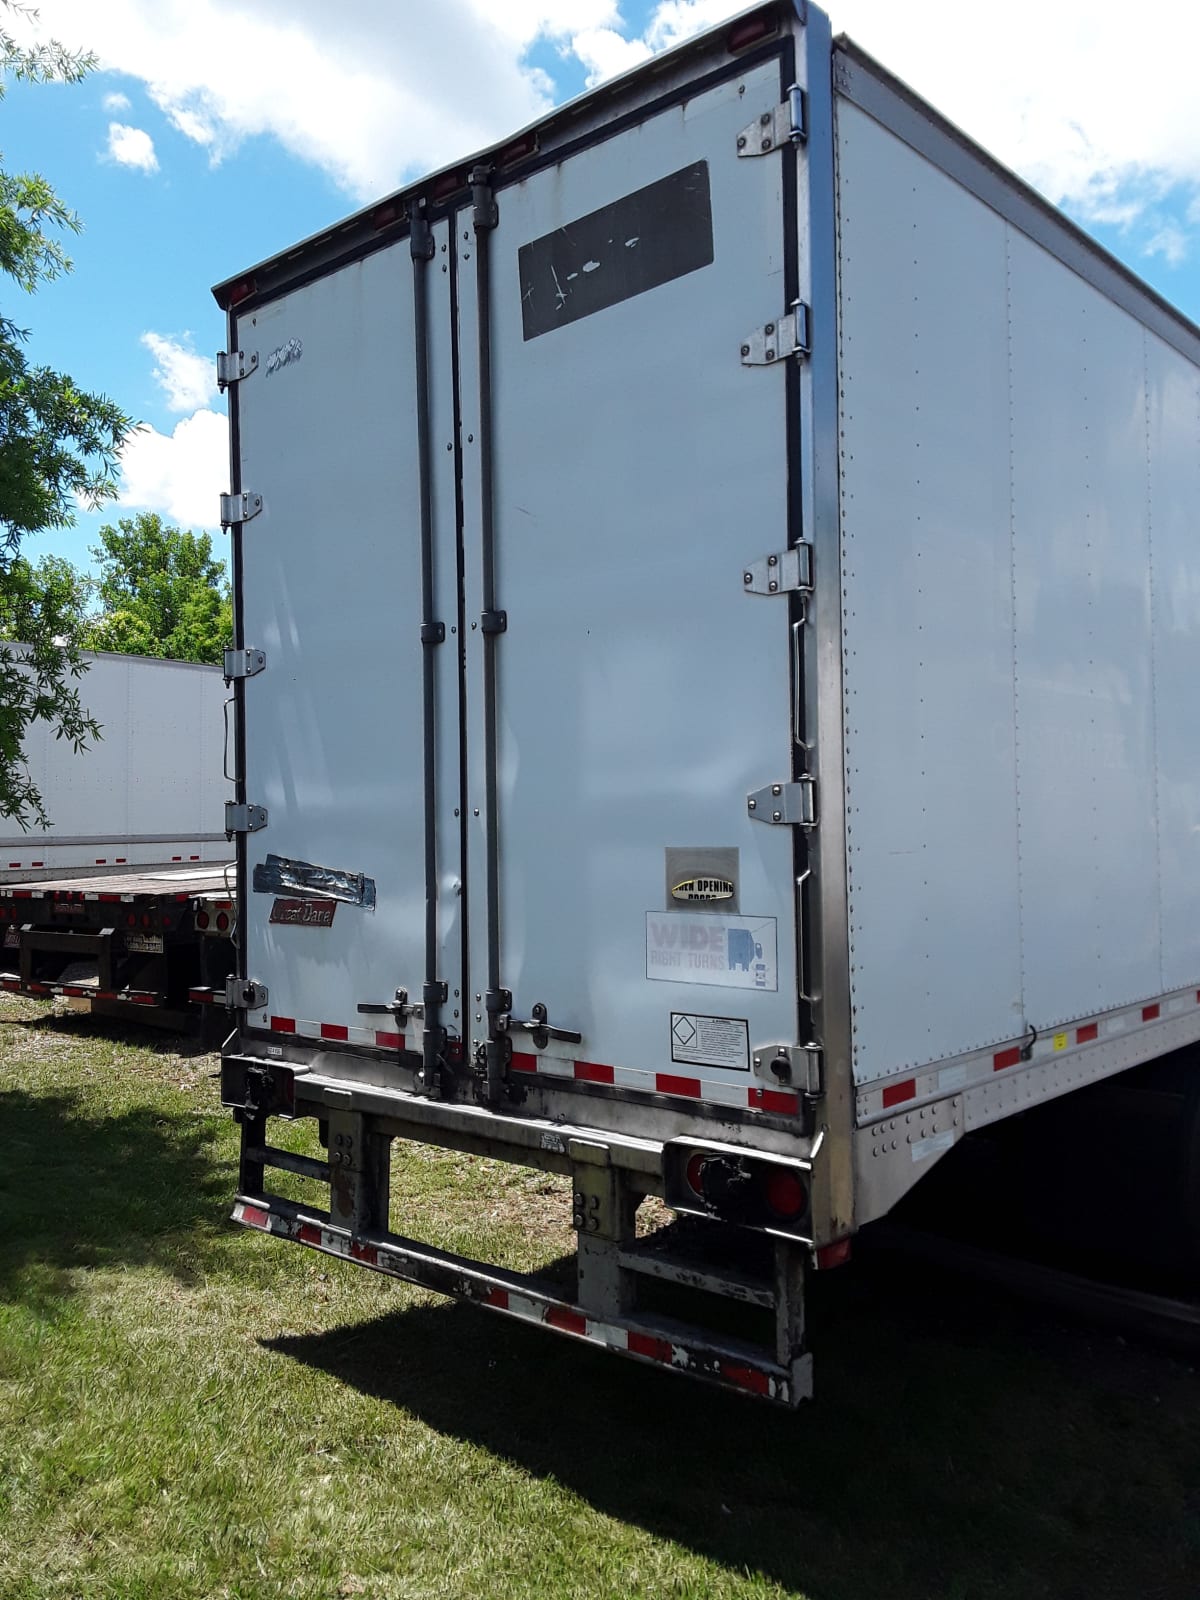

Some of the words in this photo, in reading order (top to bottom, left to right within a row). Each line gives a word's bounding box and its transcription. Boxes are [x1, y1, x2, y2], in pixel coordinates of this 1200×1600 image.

[650, 921, 724, 952] WIDE
[651, 950, 681, 967] RIGHT
[688, 953, 725, 970] TURNS
